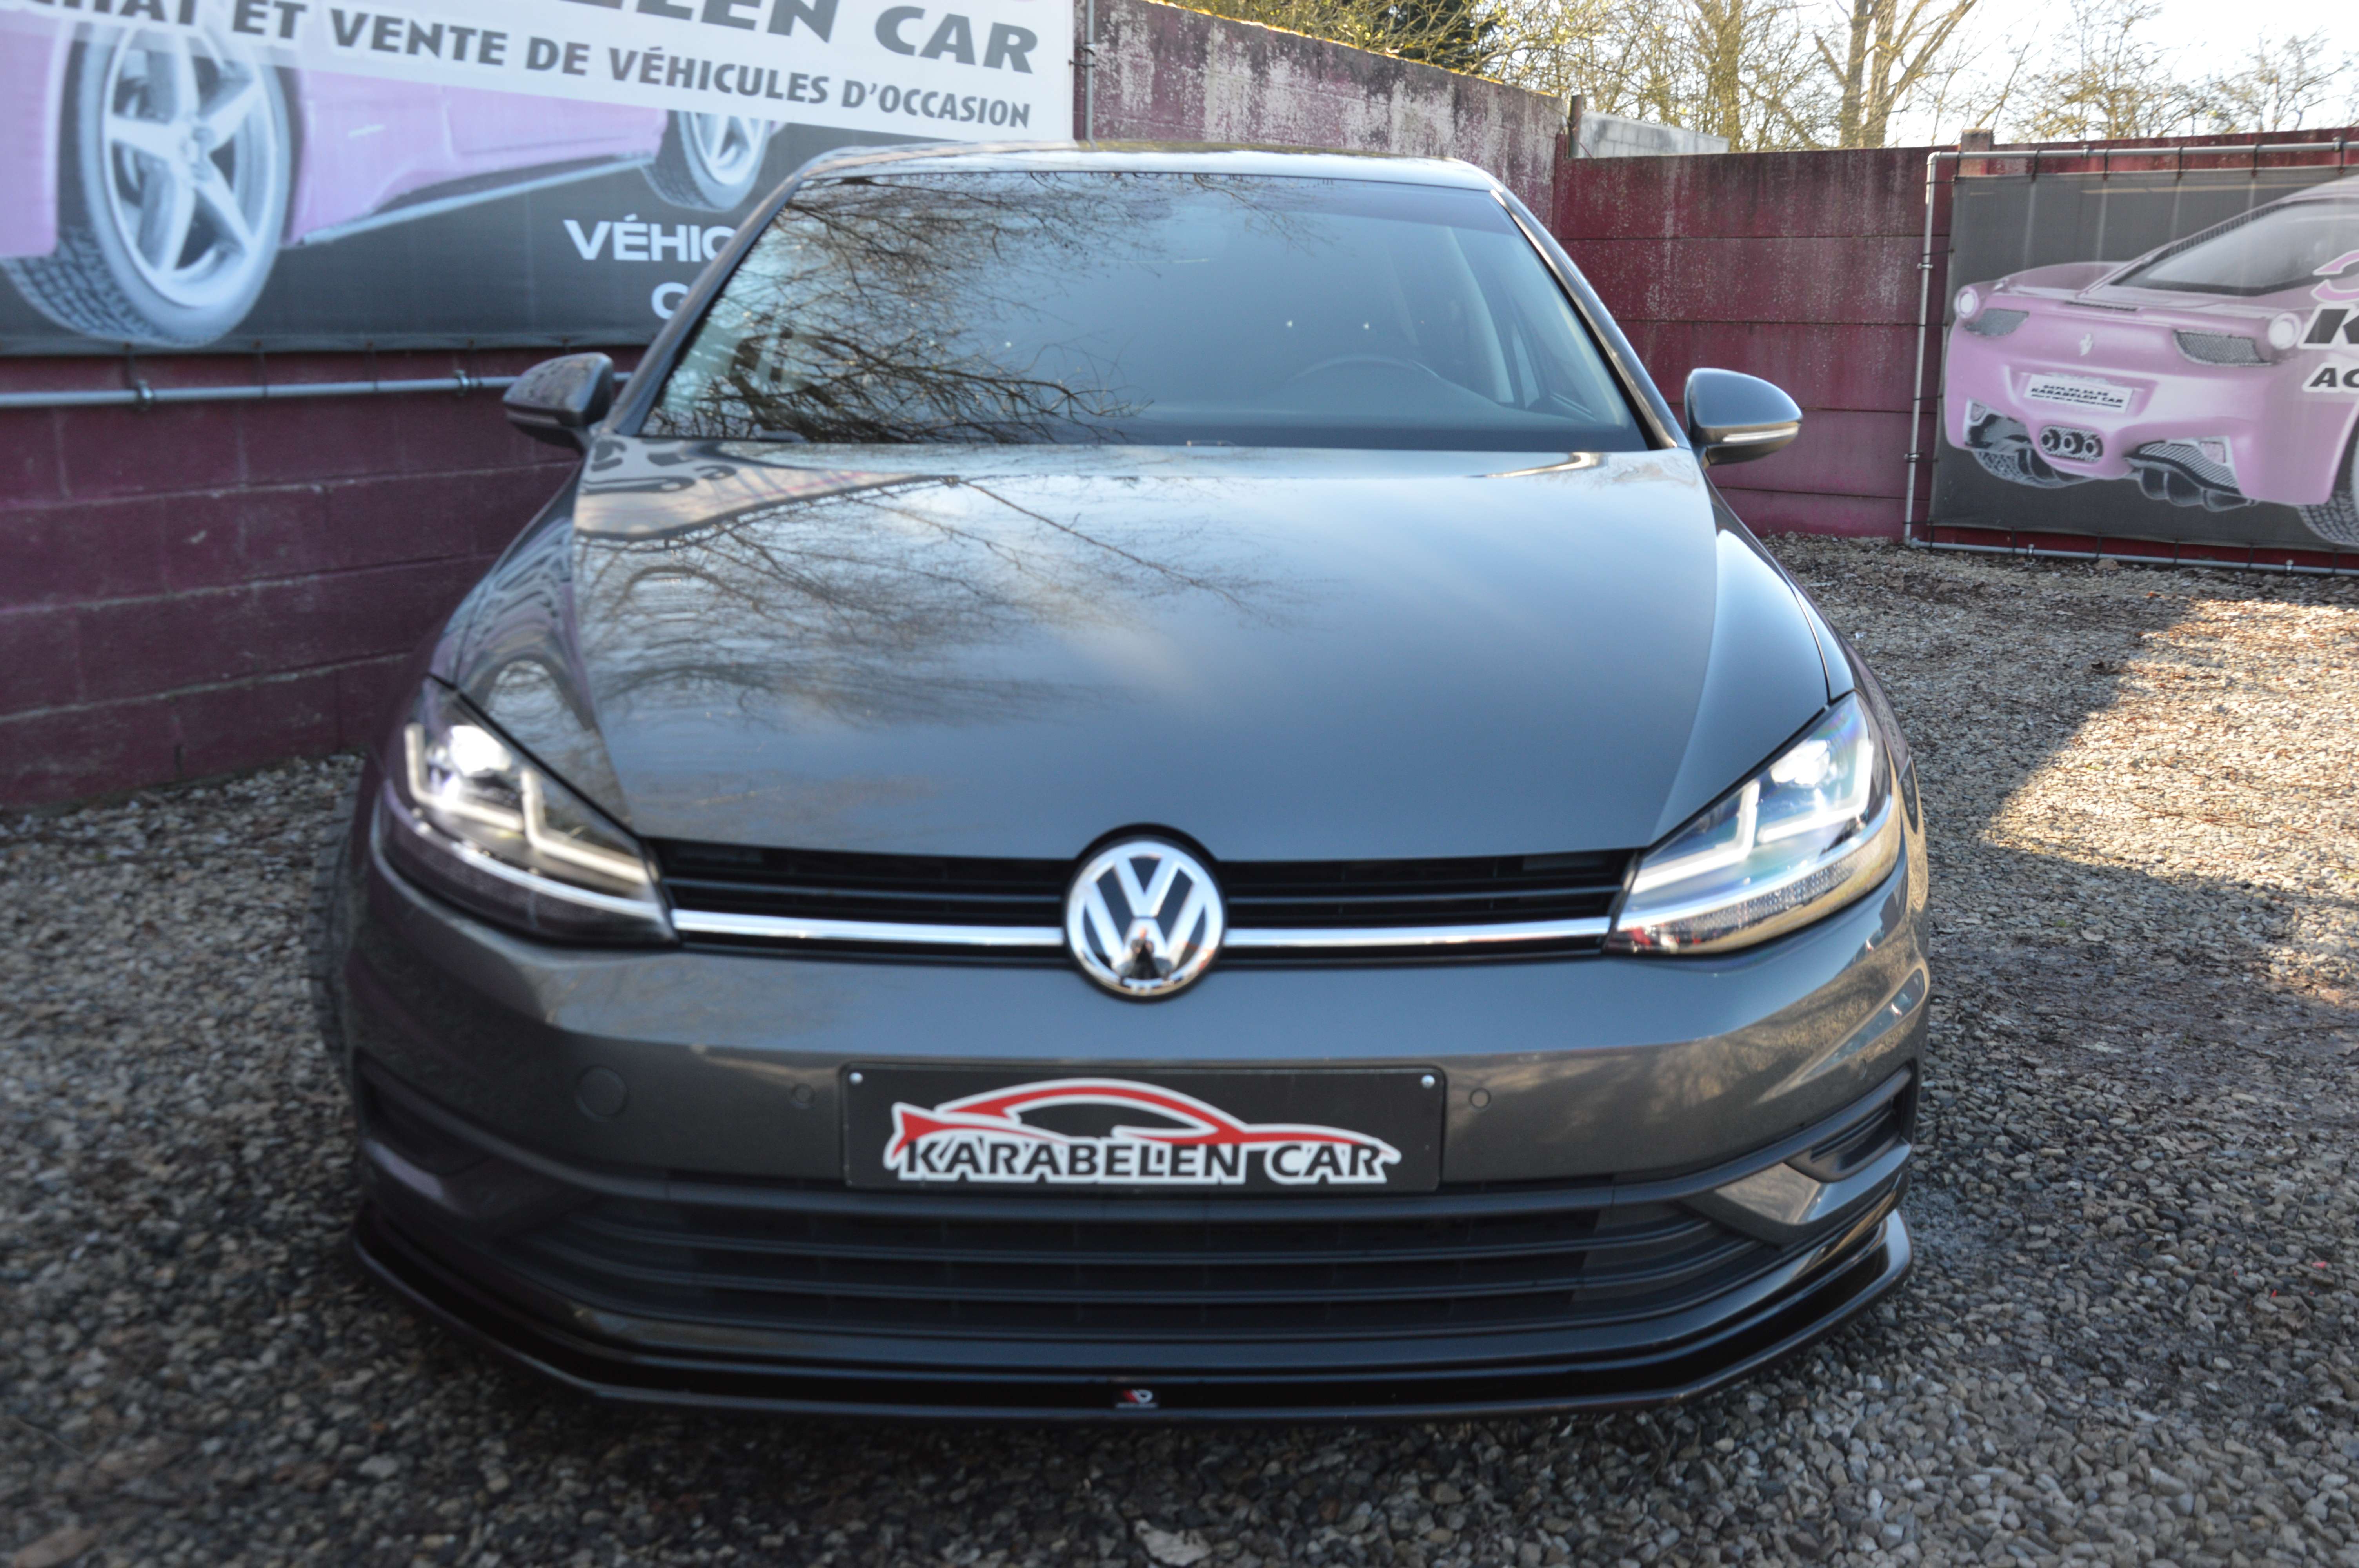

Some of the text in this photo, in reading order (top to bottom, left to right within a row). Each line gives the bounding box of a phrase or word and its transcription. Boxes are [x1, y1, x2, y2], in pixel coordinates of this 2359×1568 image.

[232, 0, 307, 39] ET
[330, 8, 508, 66] VENTE
[525, 36, 591, 76] DE
[609, 46, 829, 105] VÉHICULES
[841, 79, 1030, 129] D'OCCASION
[875, 5, 1038, 74] CAR
[905, 1140, 1382, 1178] KARABELEN CAR
